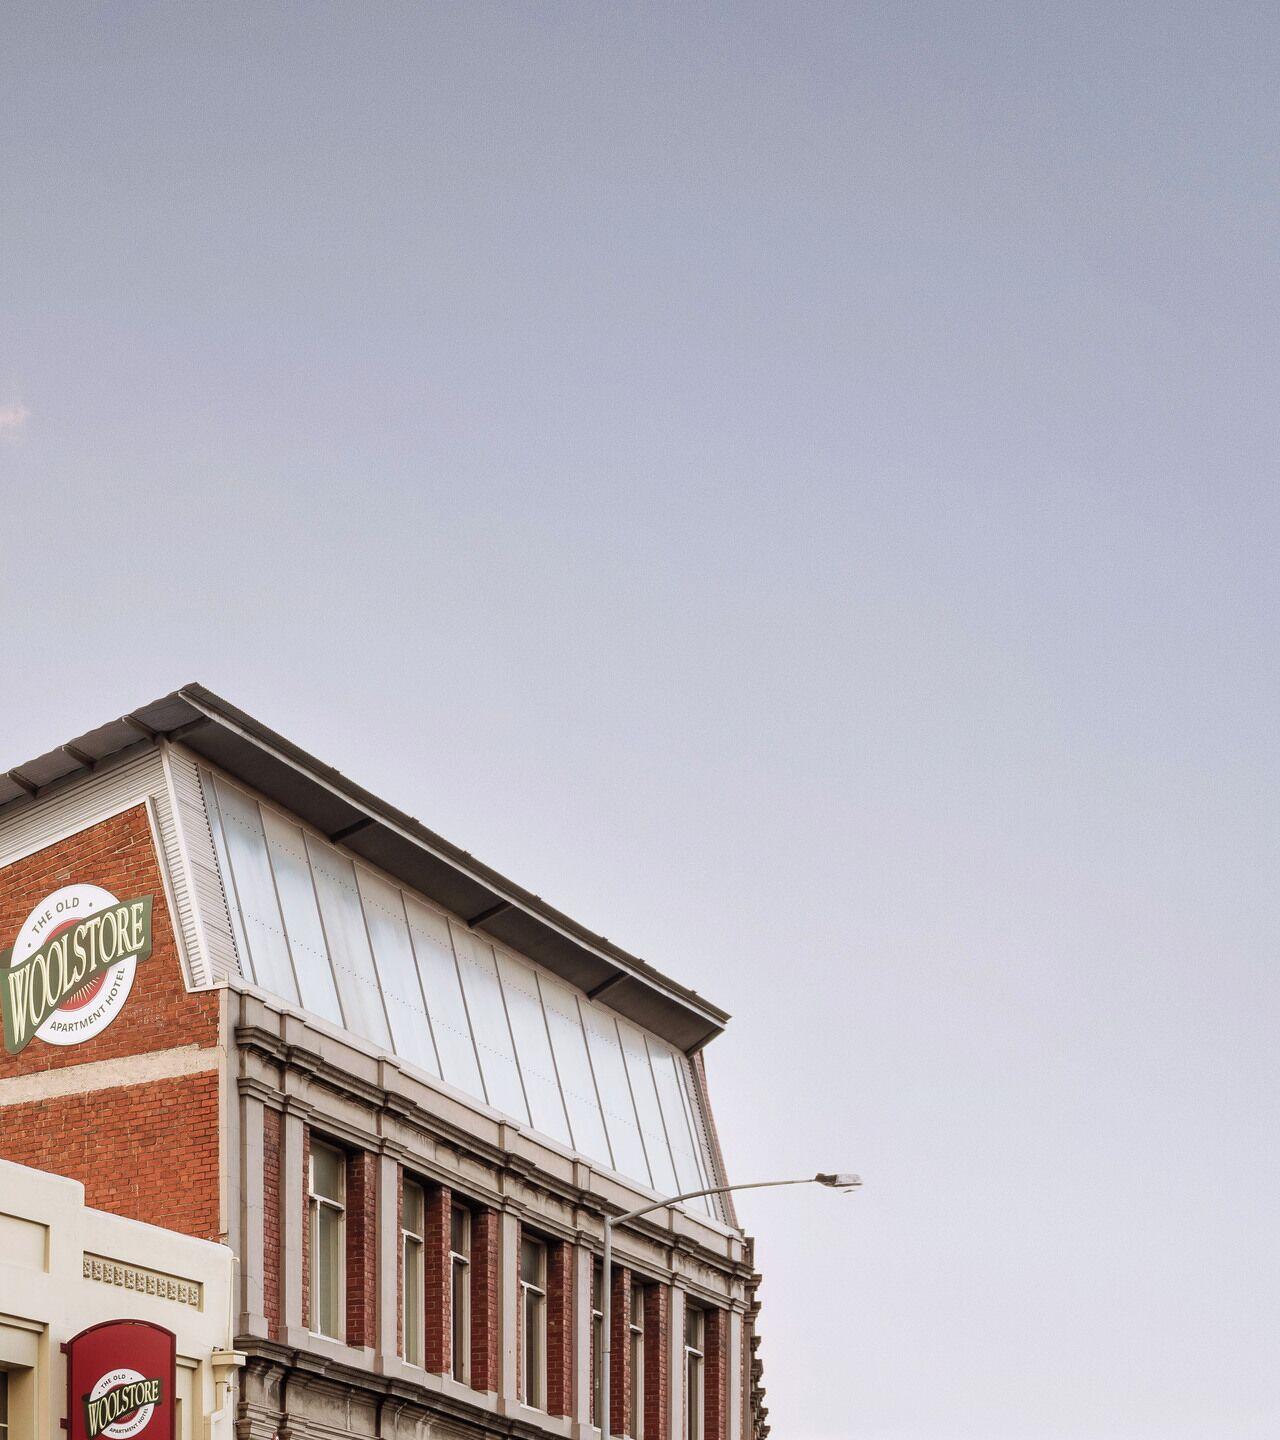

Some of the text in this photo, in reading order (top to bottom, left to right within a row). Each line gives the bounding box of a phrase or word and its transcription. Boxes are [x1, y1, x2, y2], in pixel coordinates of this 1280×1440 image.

[32, 897, 80, 934] THE OLD
[8, 902, 145, 1045] WOOLSTORE
[50, 967, 126, 1032] APARTMENT HOTEL
[100, 1379, 112, 1389] THE
[88, 1380, 160, 1437] WOOLSTORE
[109, 1408, 149, 1434] APARTMENT HOTEL
